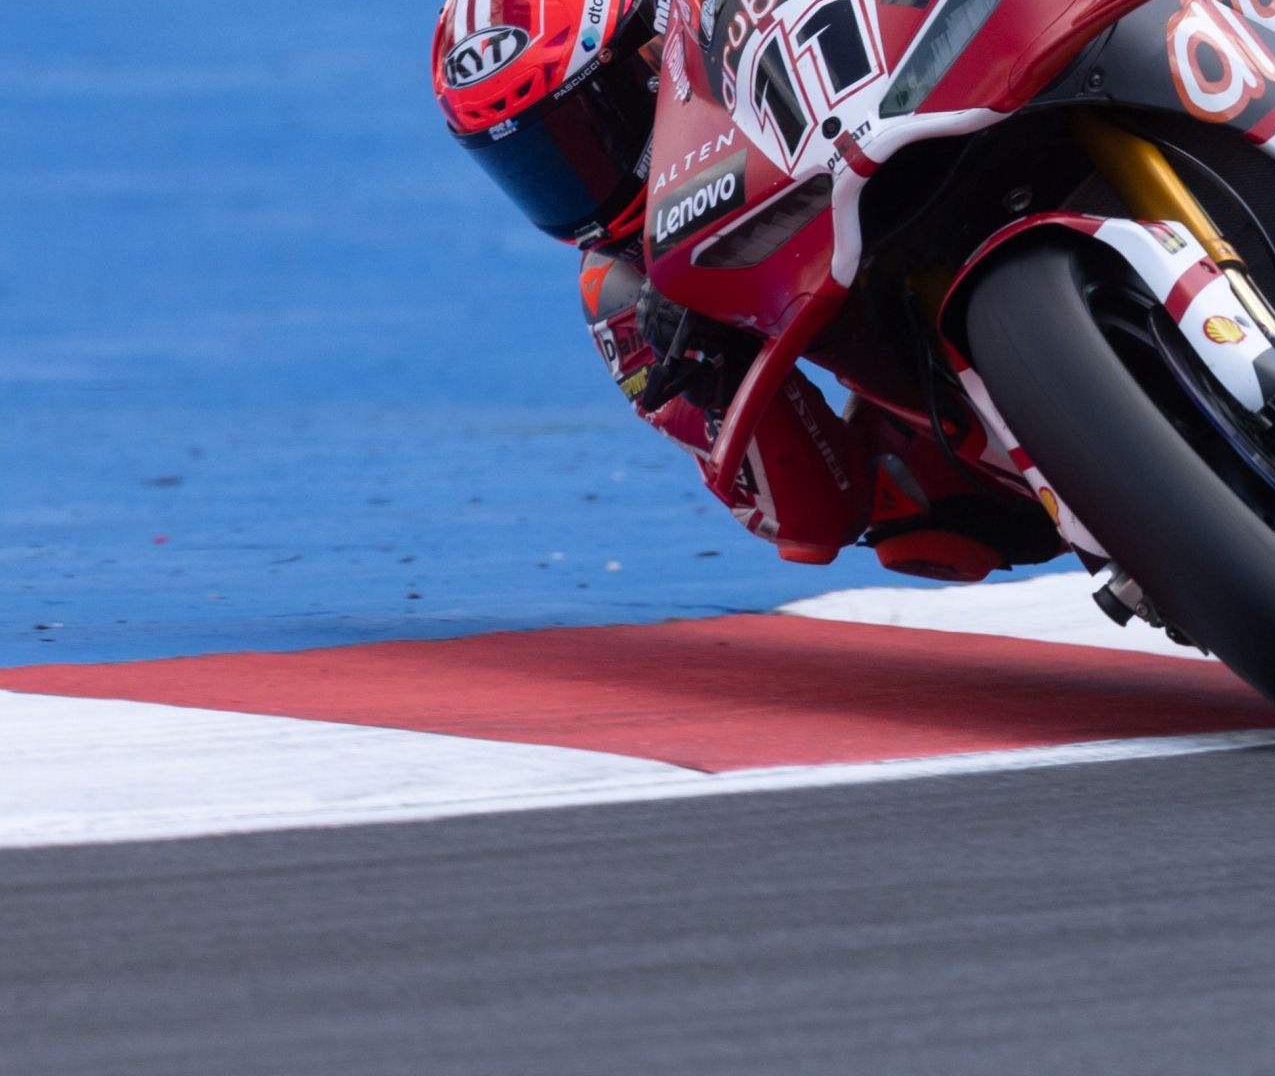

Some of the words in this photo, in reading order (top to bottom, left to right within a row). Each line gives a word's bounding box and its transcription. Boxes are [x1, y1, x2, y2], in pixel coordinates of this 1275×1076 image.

[446, 27, 515, 88] KYT
[552, 60, 600, 100] PASCUCCI
[652, 127, 736, 196] ALTEN
[655, 172, 736, 244] Lenovo
